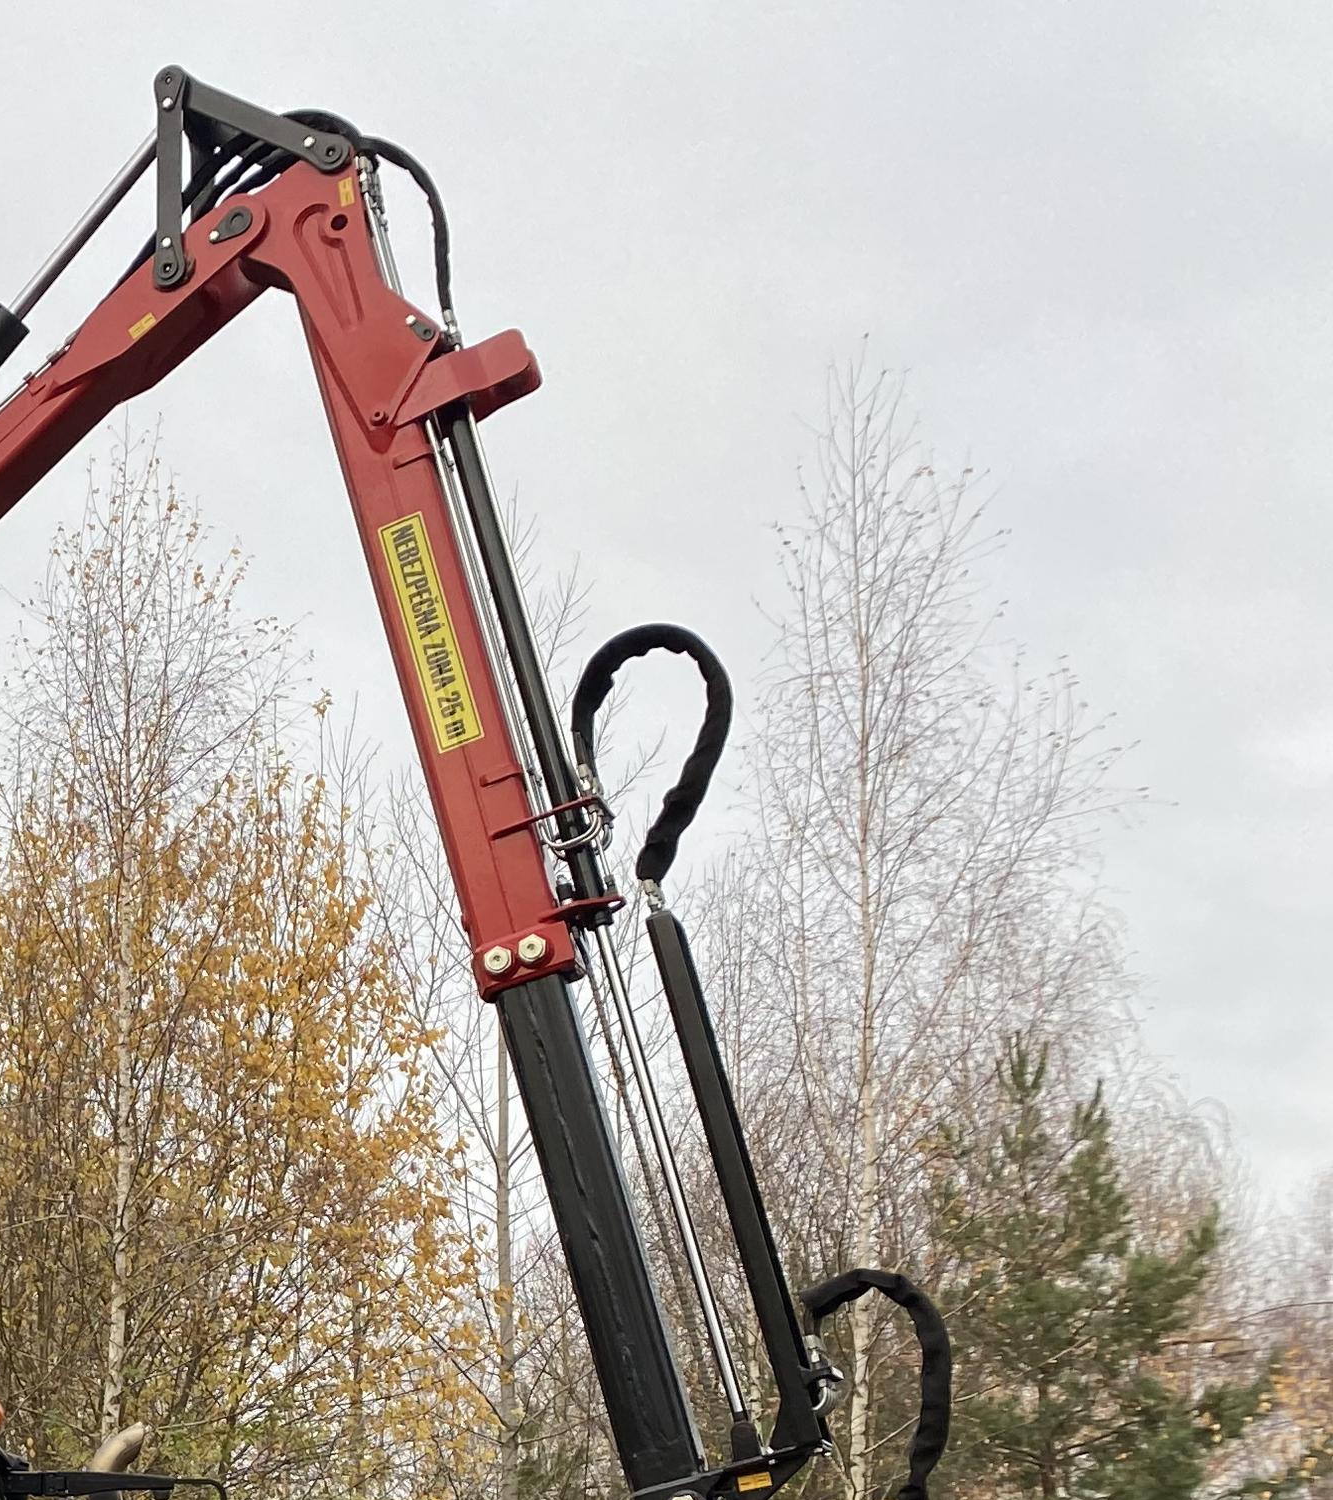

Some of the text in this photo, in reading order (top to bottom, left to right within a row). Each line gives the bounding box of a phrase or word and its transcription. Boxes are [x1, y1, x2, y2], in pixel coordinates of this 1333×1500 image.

[391, 523, 466, 740] NEBEZPEČNÁ ZÓNA 25 m
